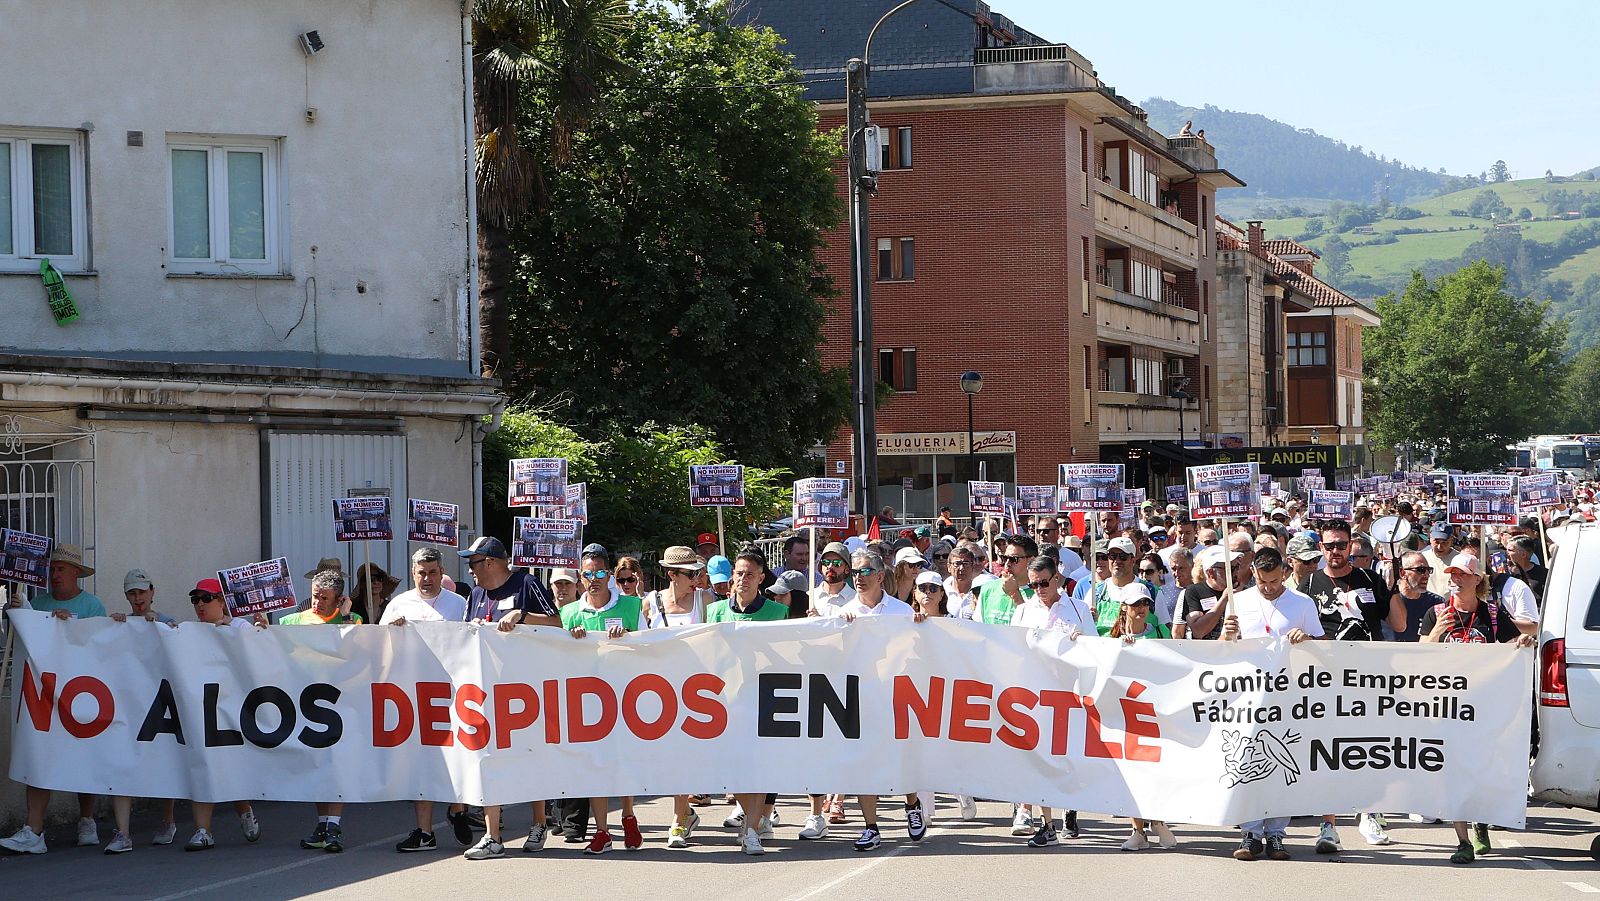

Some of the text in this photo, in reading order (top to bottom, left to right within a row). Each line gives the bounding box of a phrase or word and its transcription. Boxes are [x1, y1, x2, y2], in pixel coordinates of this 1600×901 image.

[877, 437, 956, 448] ELUQUERIA
[1247, 452, 1266, 464] EL
[1272, 448, 1327, 464] ANDÉN
[24, 574, 38, 582] ERE!
[264, 600, 282, 608] ERE!
[1198, 666, 1468, 694] Comité de Empresa
[17, 661, 1162, 762] NO A LOS DESPIDOS EN NESTLÉ
[1192, 696, 1476, 724] Fábrica de La Penilla
